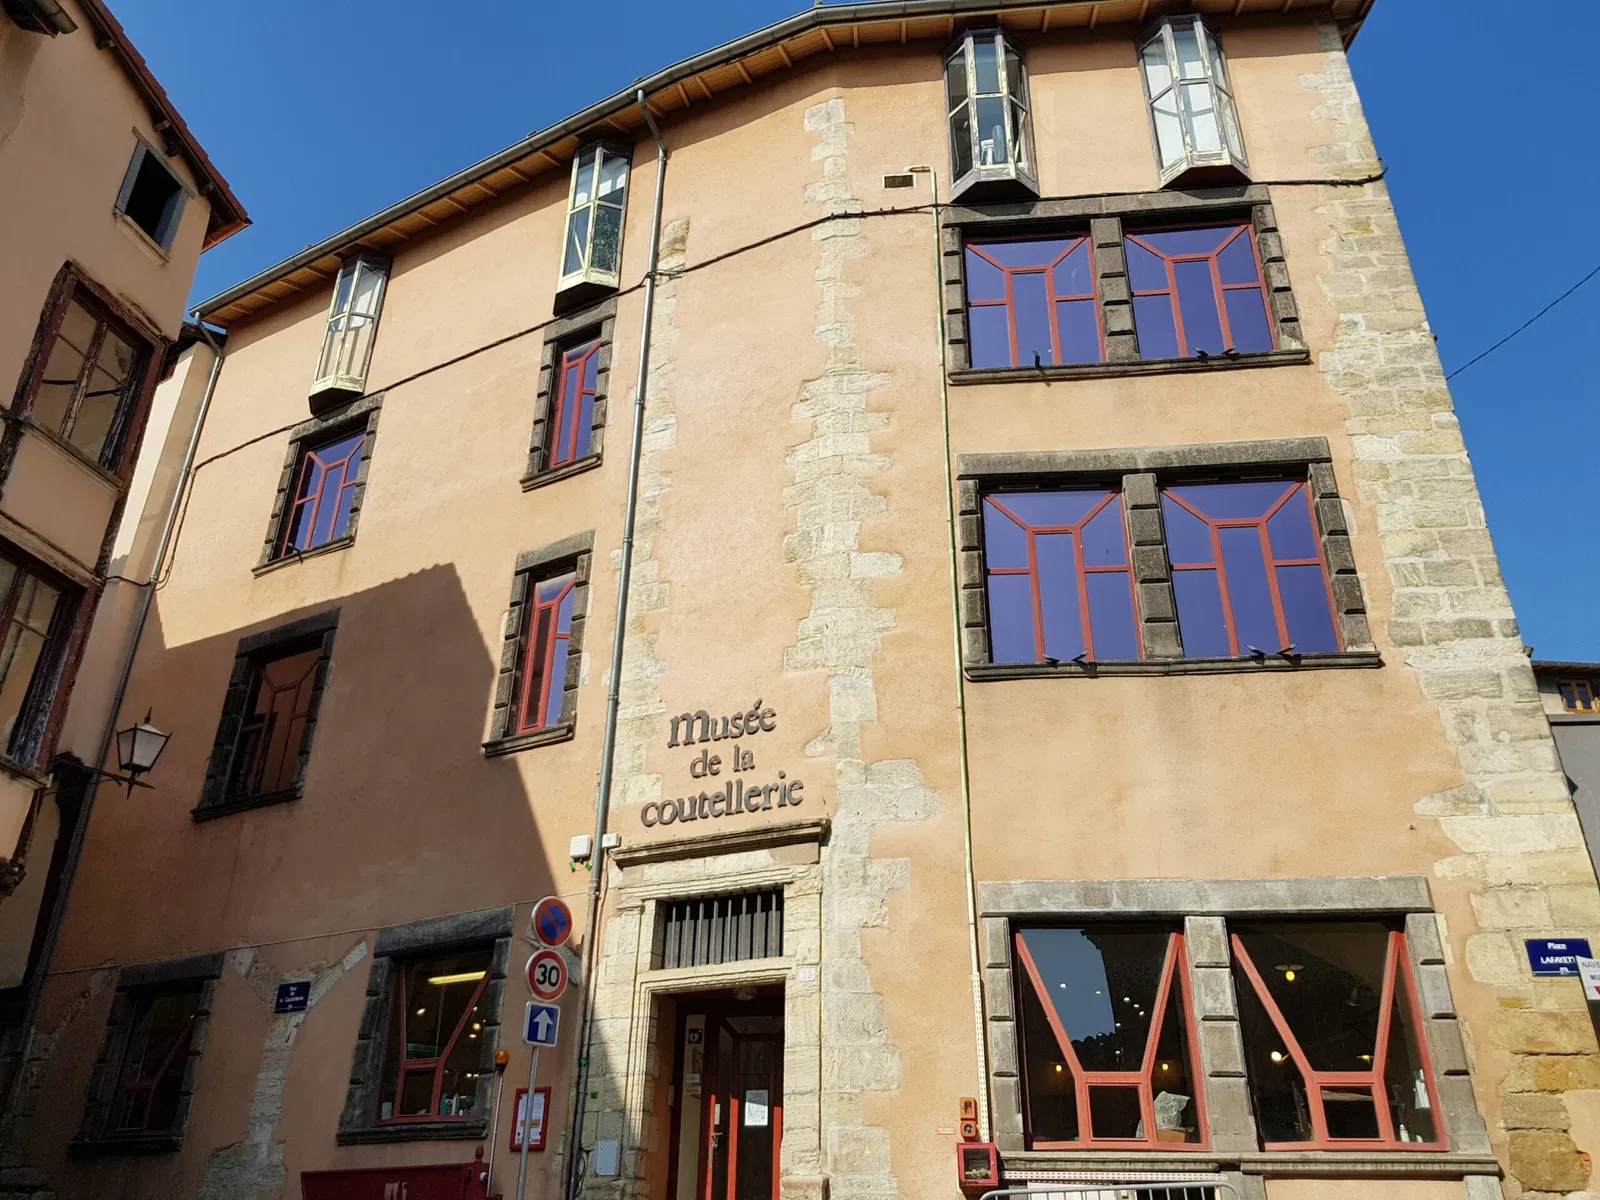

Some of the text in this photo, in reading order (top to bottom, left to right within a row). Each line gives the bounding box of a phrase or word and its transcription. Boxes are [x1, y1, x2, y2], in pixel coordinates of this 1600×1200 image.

[690, 744, 755, 779] de la
[641, 770, 804, 827] coutellerie
[536, 963, 560, 987] 30
